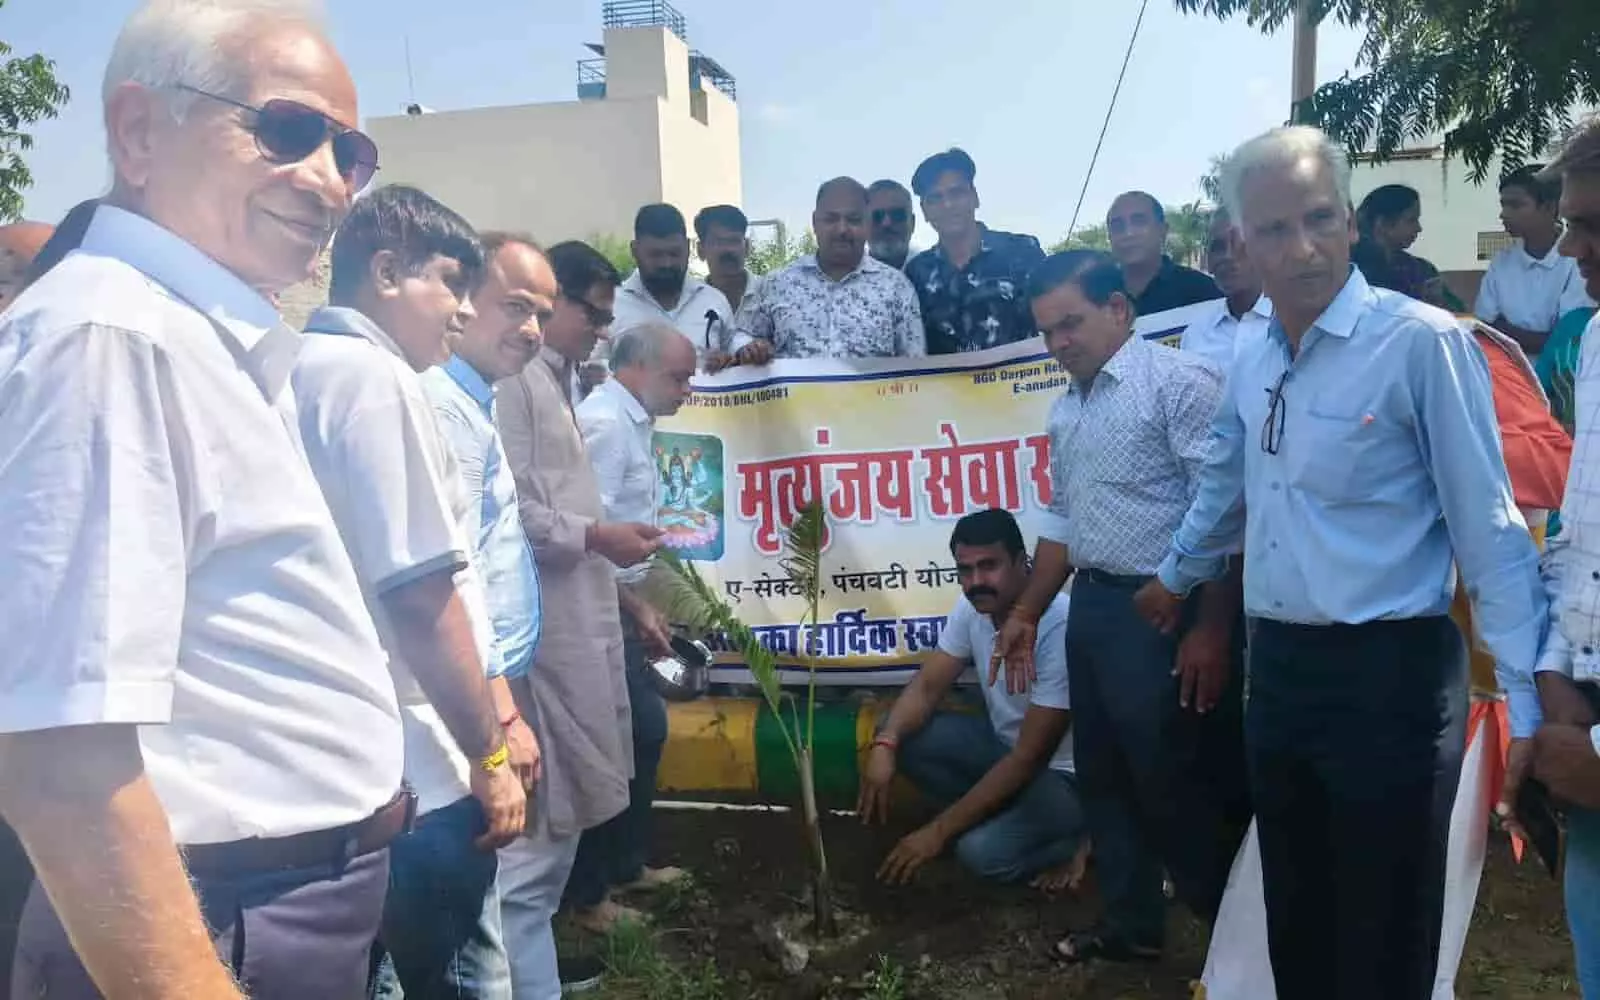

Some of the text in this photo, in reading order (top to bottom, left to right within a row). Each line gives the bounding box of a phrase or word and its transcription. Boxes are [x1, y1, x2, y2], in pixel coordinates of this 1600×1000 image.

[1000, 366, 1040, 383] Darpan
[736, 428, 914, 552] मृत्युंजय
[920, 422, 1019, 517] सेवा
[831, 562, 908, 594] पंचवटी
[915, 560, 960, 588] योज
[802, 607, 897, 657] हार्दिक
